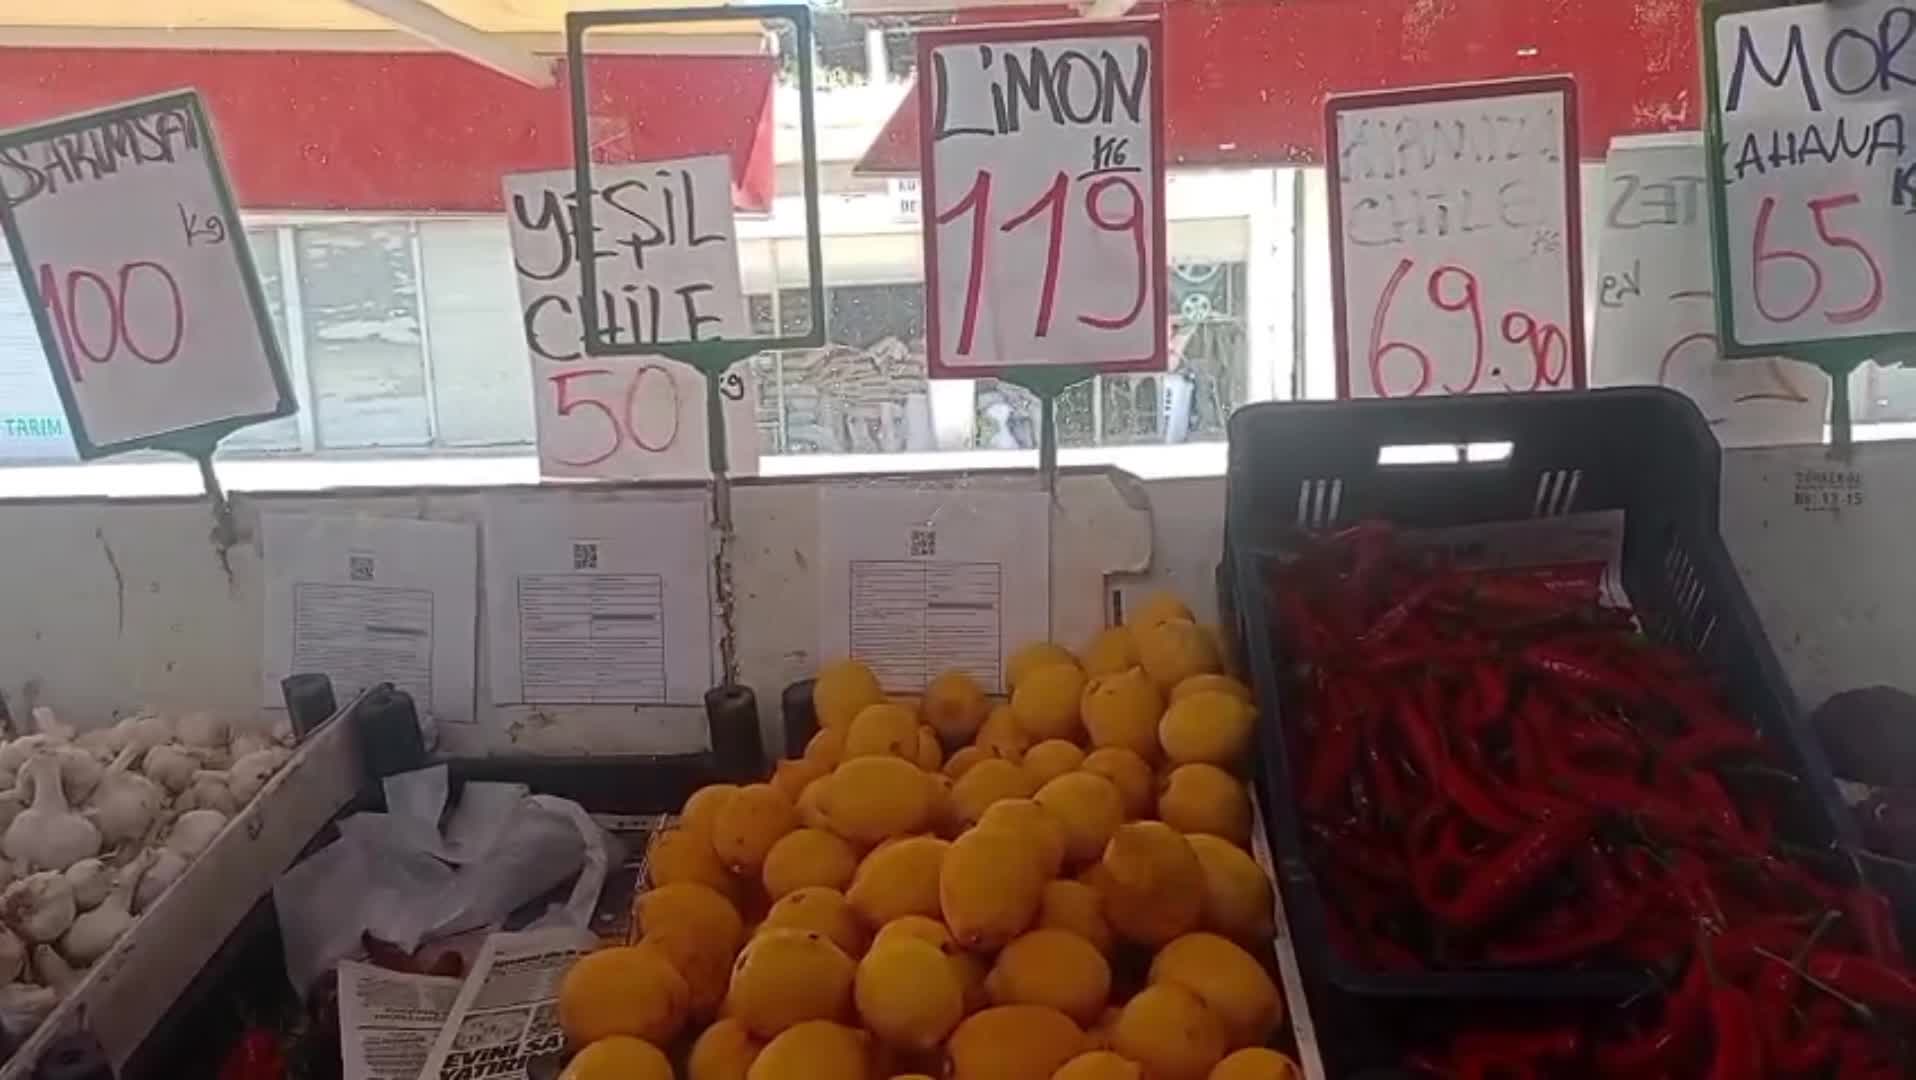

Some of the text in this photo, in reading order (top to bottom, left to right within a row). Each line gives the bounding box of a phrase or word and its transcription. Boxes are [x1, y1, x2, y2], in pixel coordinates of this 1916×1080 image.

[1726, 8, 1916, 112] MOR
[2, 109, 198, 207] SARIMSA
[936, 170, 1147, 356] 119
[1752, 194, 1882, 323] 65
[40, 263, 183, 382] 100
[1369, 258, 1567, 398] 69.90
[5, 418, 62, 437] TARIM
[549, 364, 681, 467] 50
